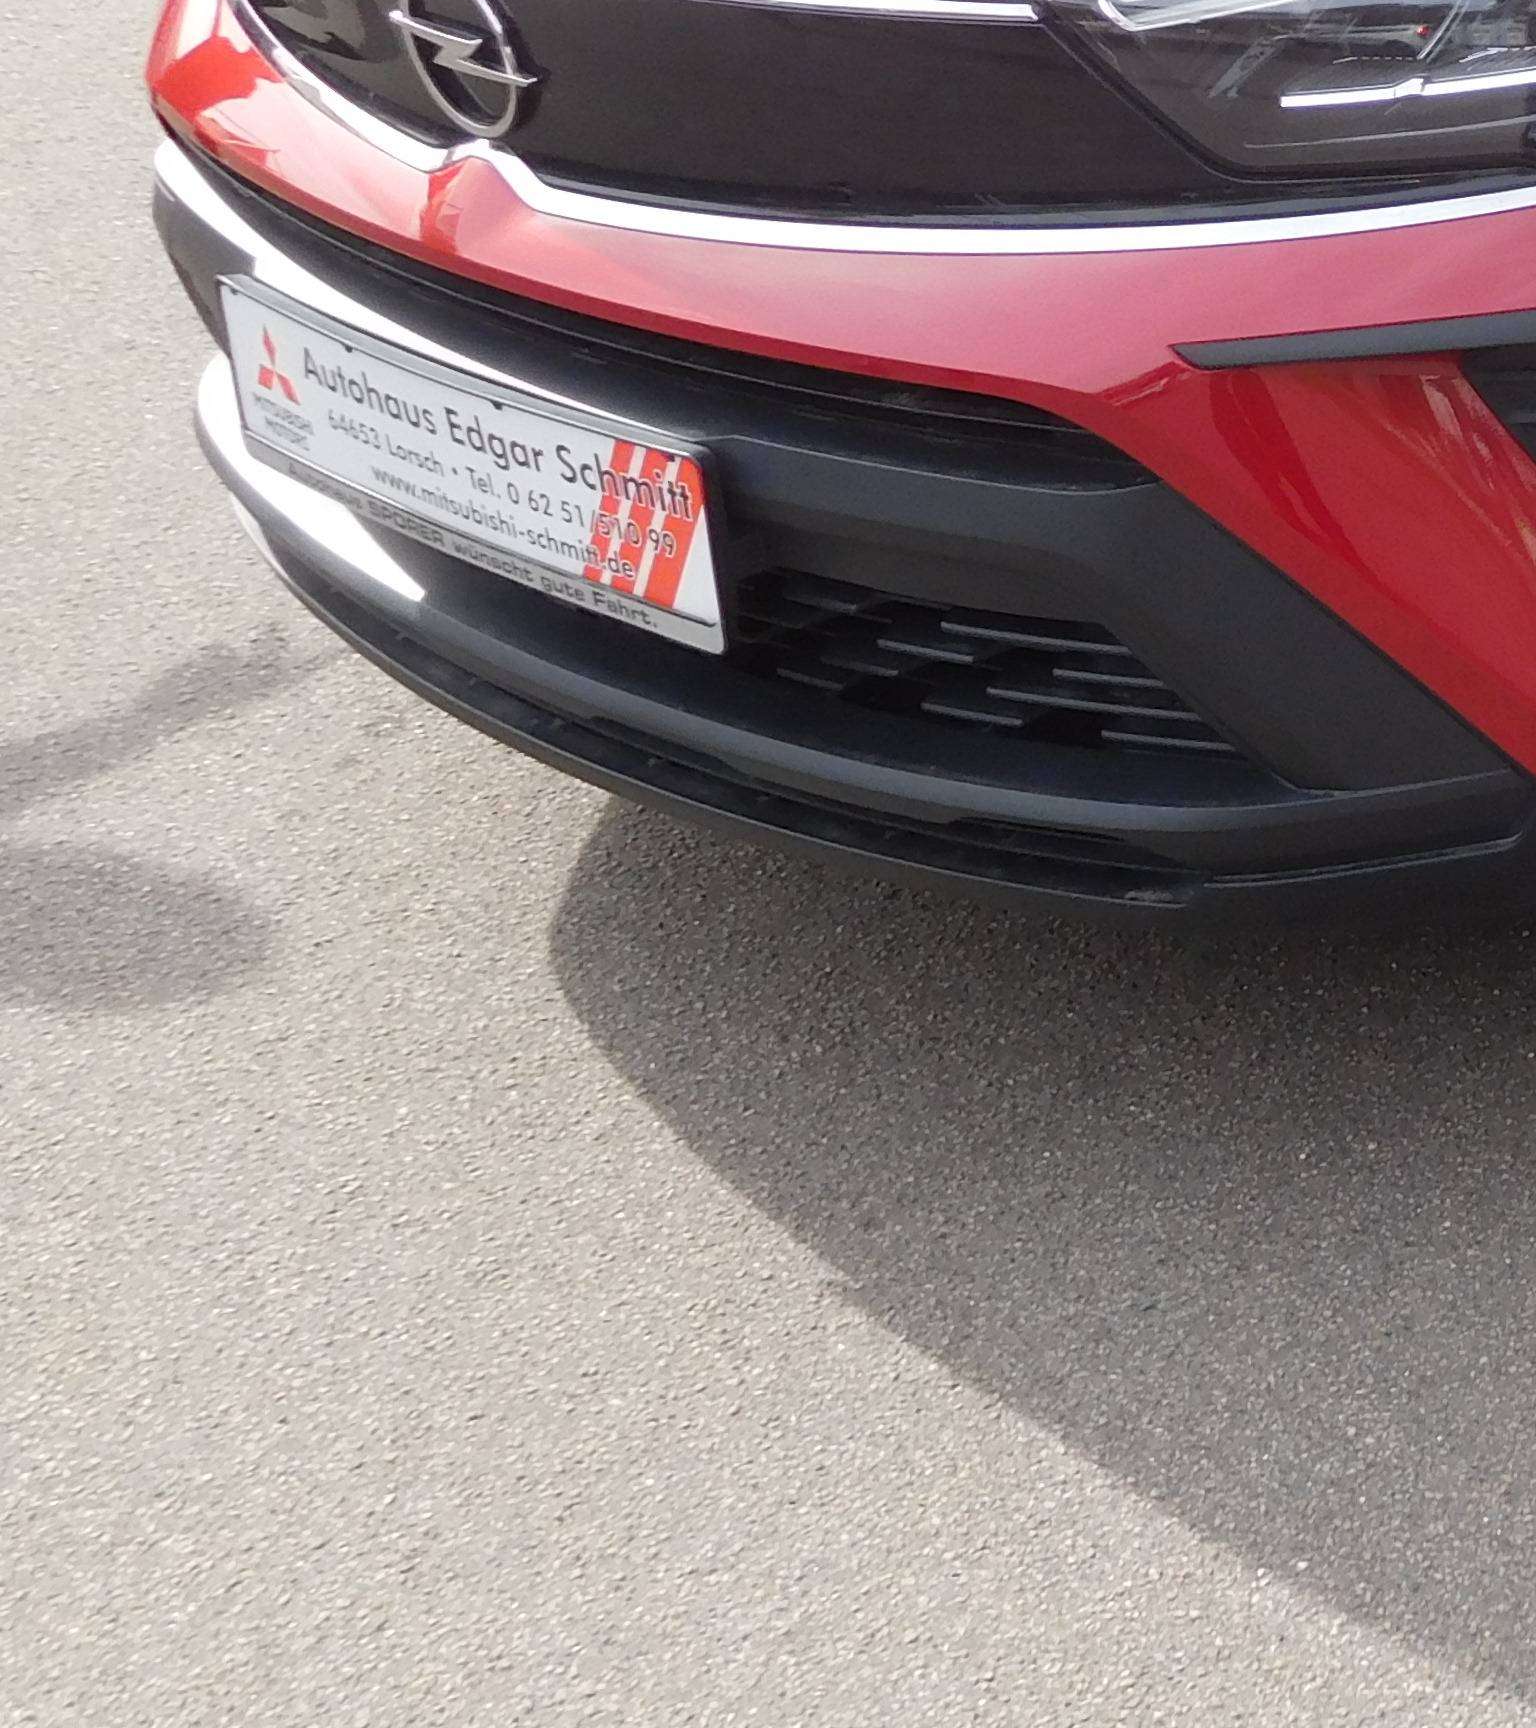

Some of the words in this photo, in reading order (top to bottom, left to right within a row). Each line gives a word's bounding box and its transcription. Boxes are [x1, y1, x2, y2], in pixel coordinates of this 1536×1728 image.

[304, 345, 438, 436] Autohaus
[444, 406, 544, 471] Edgar
[556, 443, 693, 520] Schmitt
[327, 409, 381, 450] 64653
[385, 433, 445, 477] Lorsch
[465, 465, 502, 500] Tel.
[506, 481, 520, 505] 0
[527, 488, 552, 517] 62
[648, 527, 677, 558] 99
[371, 466, 635, 580] www.mitsubishi-schmitt.de
[540, 576, 586, 601] gute
[593, 591, 658, 628] Fahrt.
